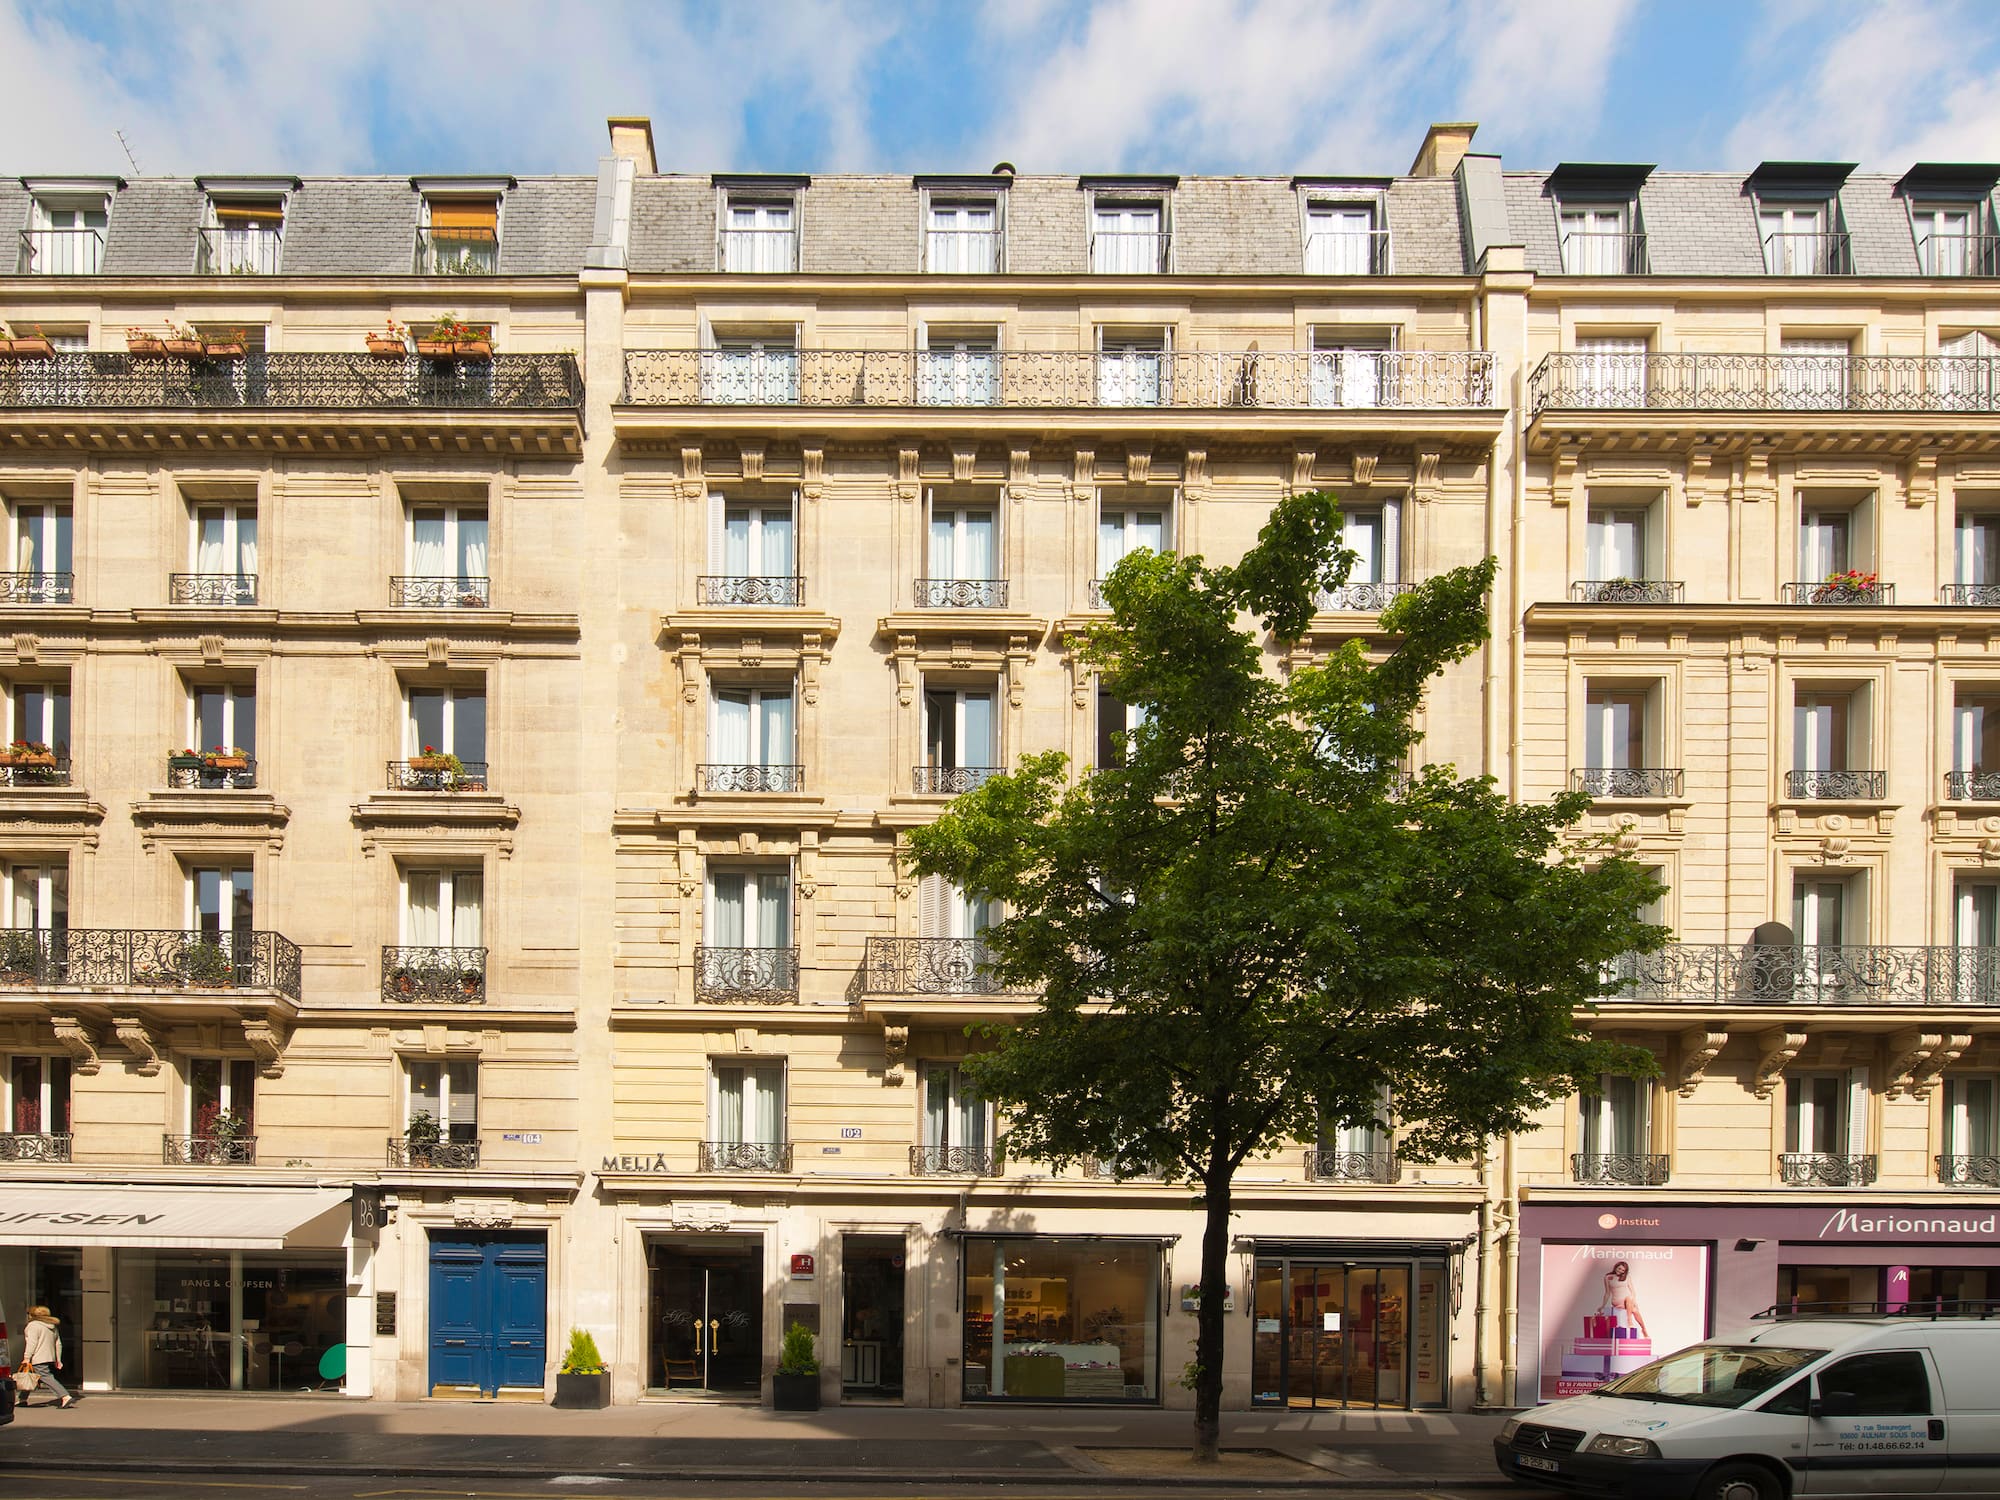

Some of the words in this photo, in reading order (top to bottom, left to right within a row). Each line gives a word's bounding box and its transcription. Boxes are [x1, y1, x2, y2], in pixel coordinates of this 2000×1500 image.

[842, 1128, 861, 1138] 102
[523, 1134, 541, 1144] 104
[1619, 1218, 1660, 1226] Institut
[1819, 1208, 1995, 1238] Marionnaud
[1571, 1245, 1673, 1263] Marionnaud
[801, 1258, 811, 1266] H
[181, 1279, 211, 1288] BANG
[214, 1280, 220, 1288] &
